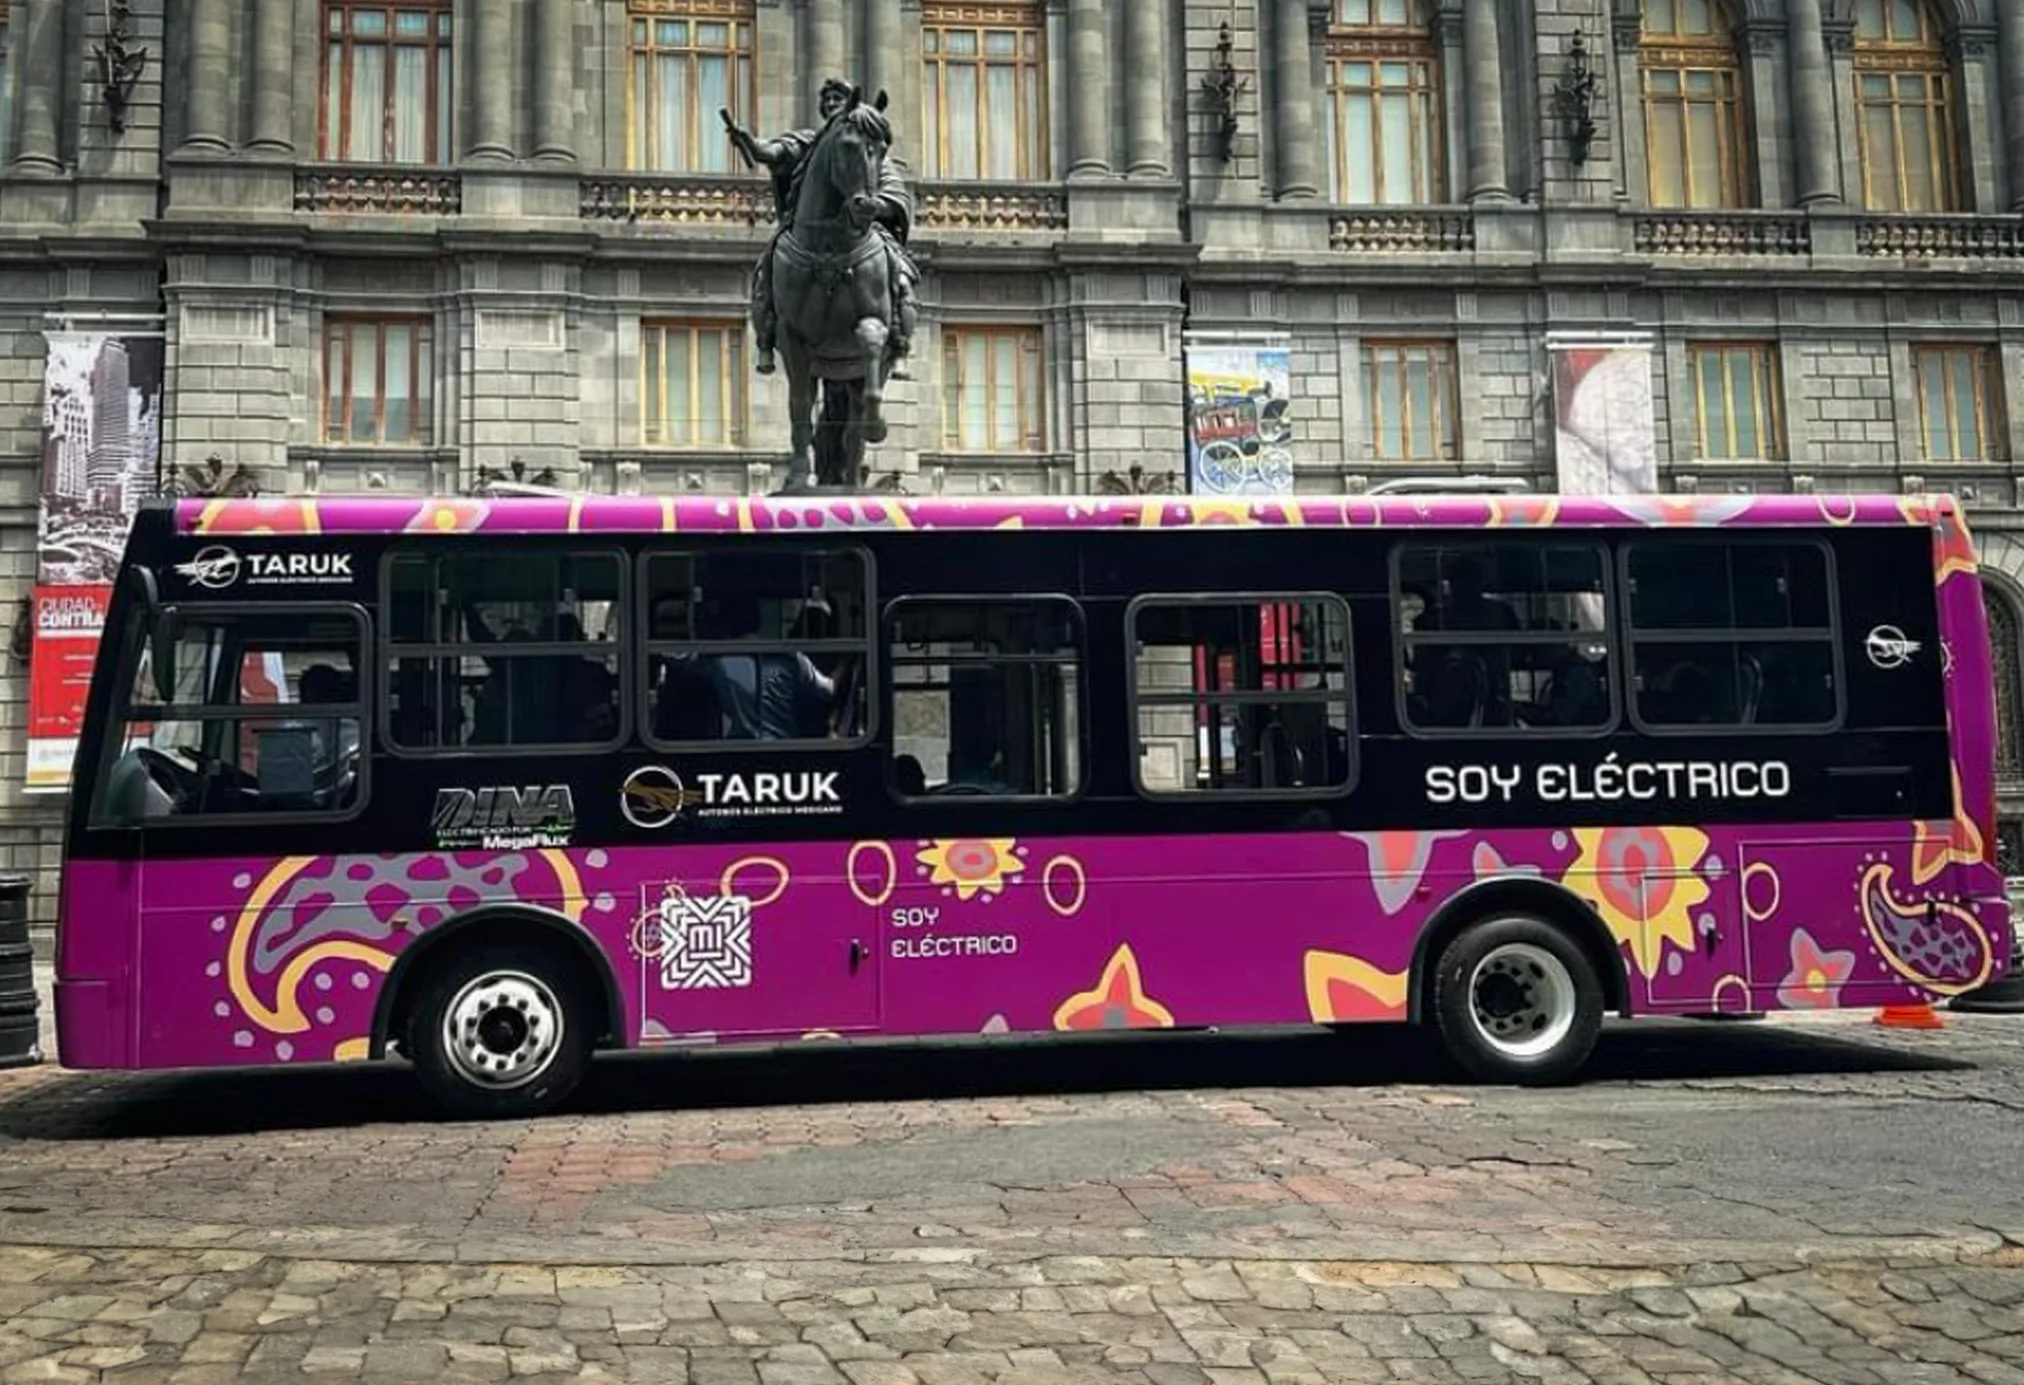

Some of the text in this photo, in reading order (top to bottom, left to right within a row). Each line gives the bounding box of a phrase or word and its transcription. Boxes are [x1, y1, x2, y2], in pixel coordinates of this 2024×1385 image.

[246, 553, 352, 575] TARUK
[696, 771, 840, 804] TARUK
[1425, 751, 1791, 801] SOY ELÉCTRICO
[430, 783, 576, 828] DINA
[482, 832, 569, 850] MegaFlux
[891, 906, 940, 927] SOY
[891, 932, 1018, 958] ELÉCTRICO
